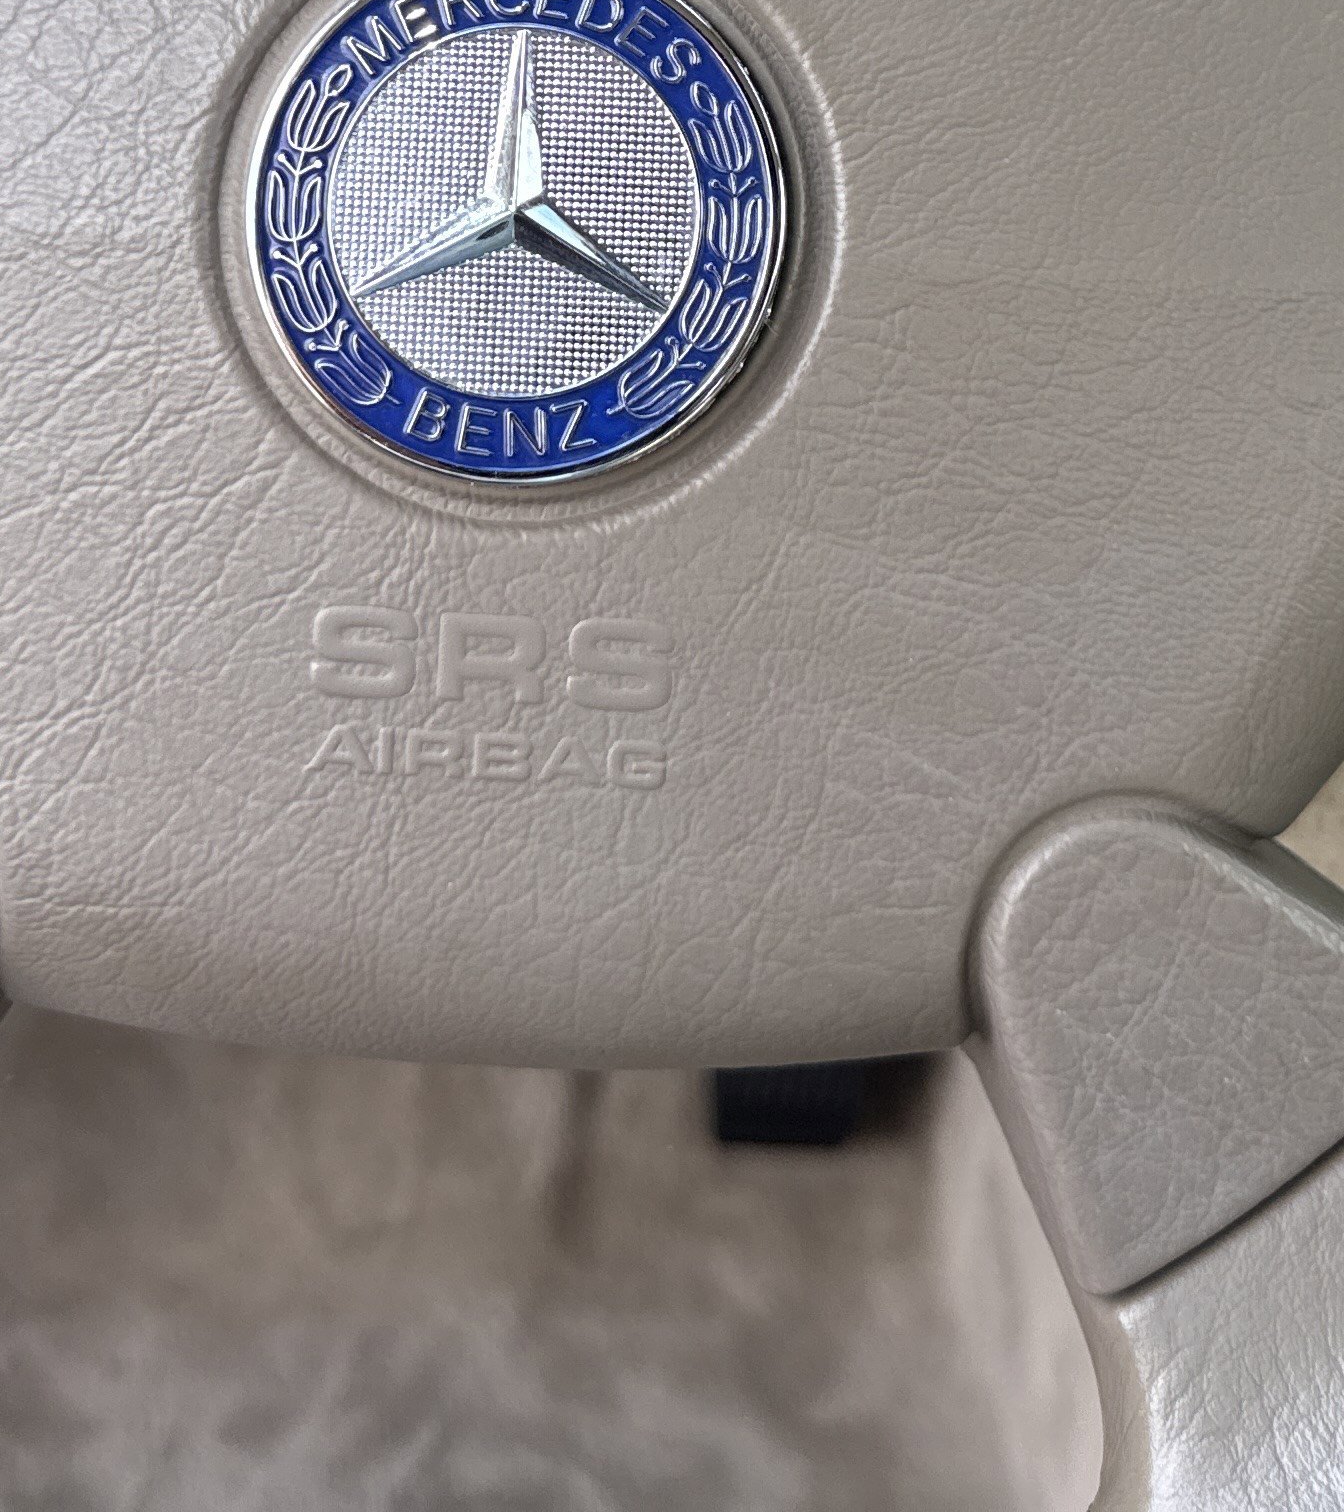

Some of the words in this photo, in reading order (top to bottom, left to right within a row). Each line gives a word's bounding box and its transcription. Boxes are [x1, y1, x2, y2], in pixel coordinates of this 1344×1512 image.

[402, 388, 596, 457] BENZ
[311, 605, 673, 711] SRS
[304, 724, 667, 788] AIRBAG
